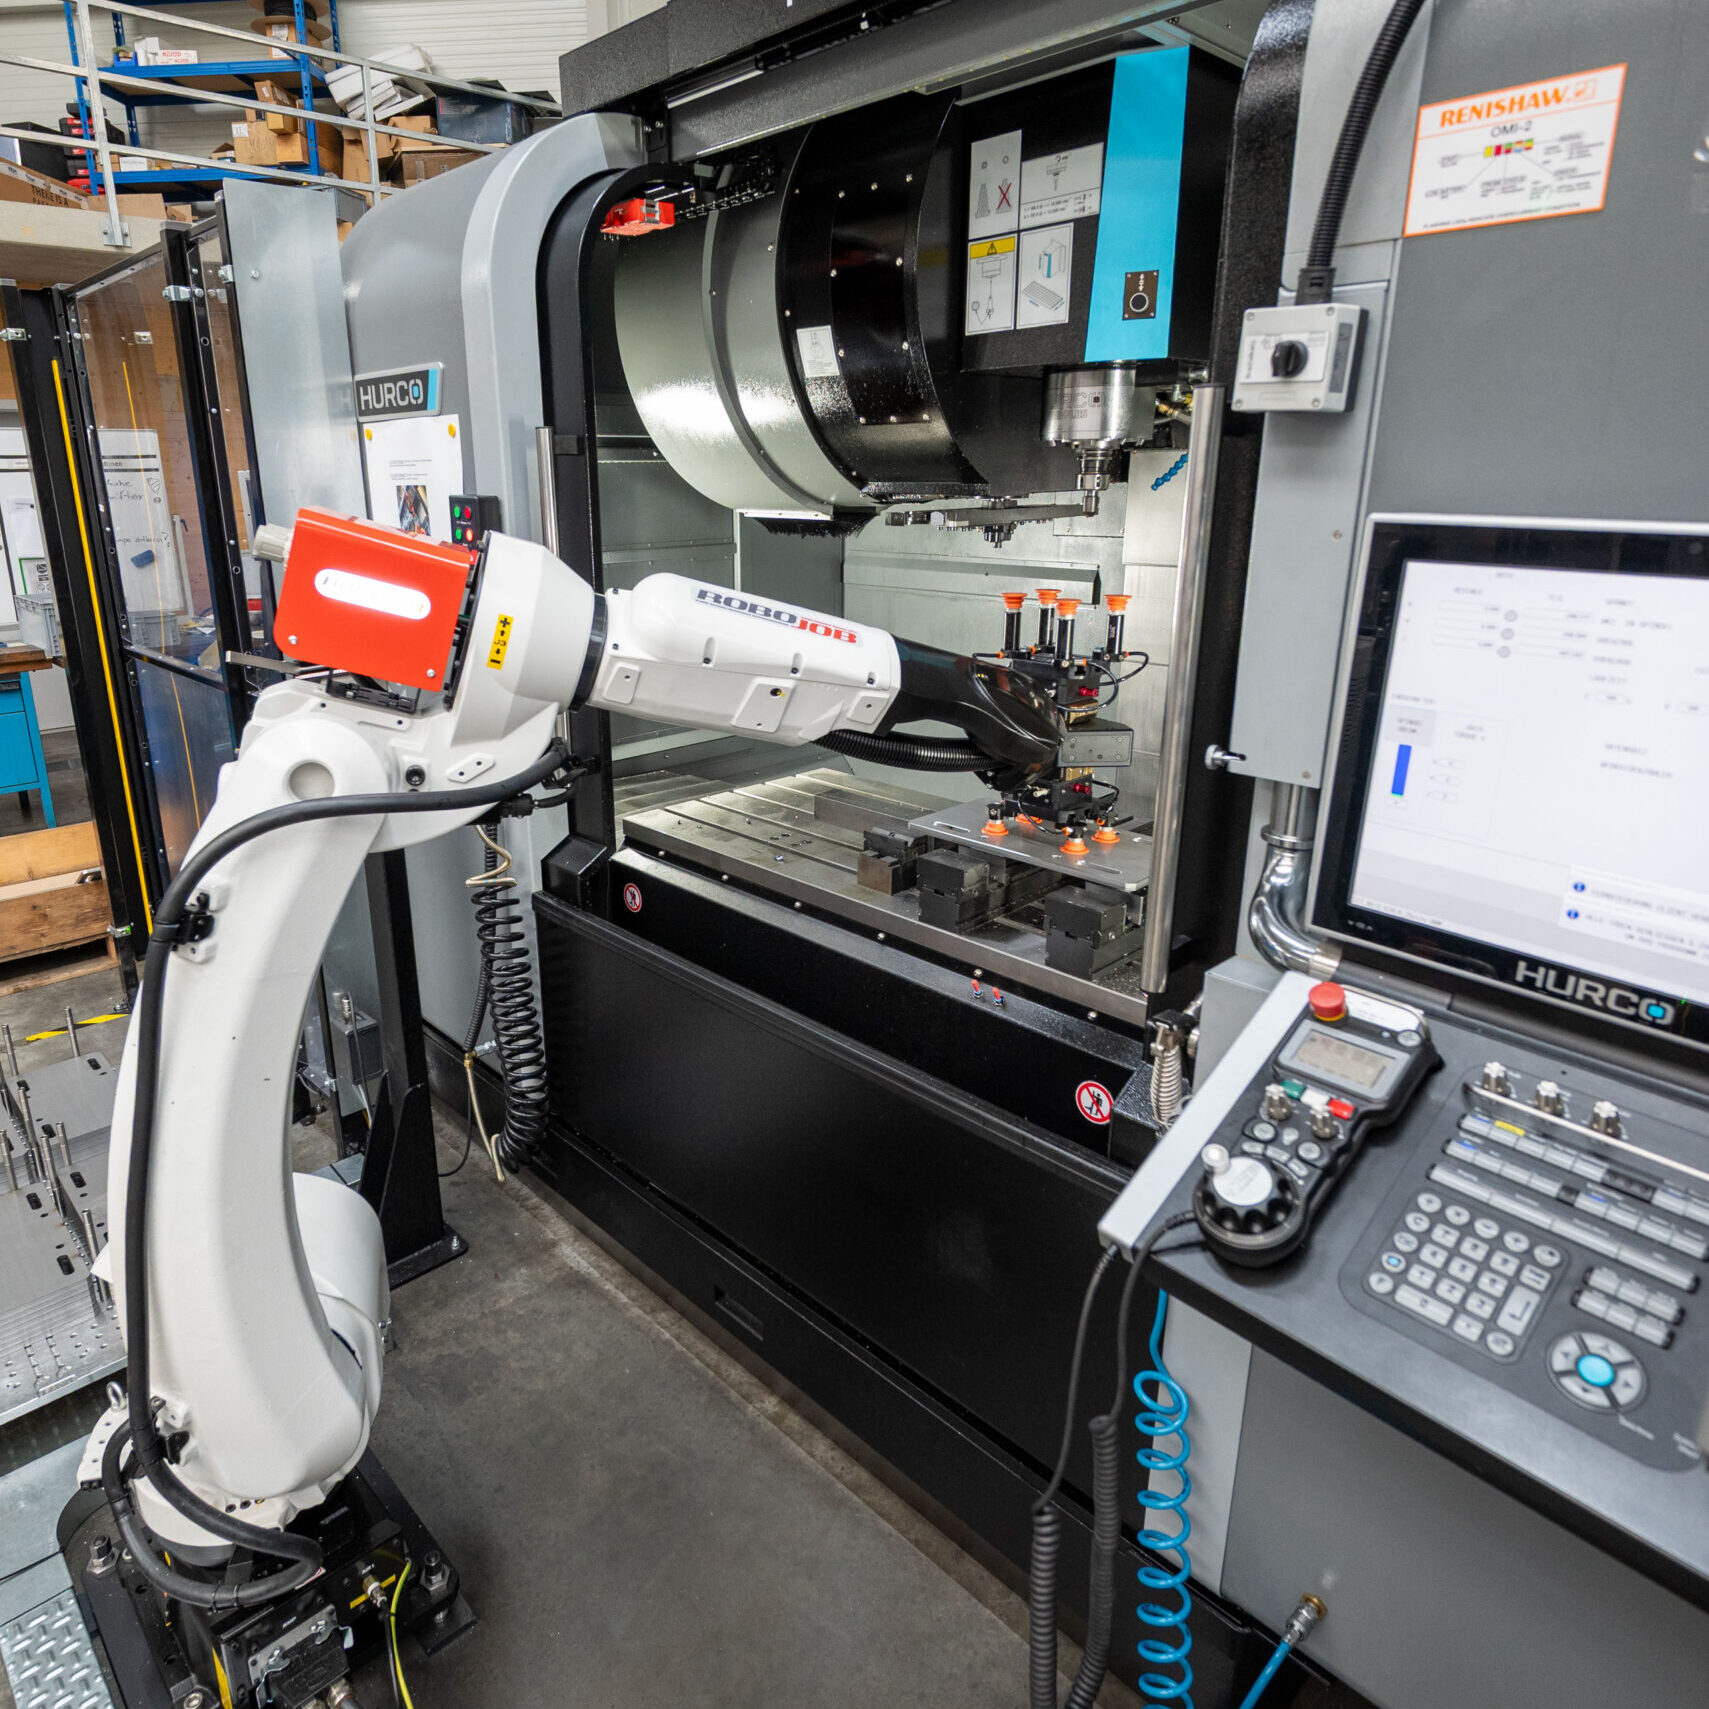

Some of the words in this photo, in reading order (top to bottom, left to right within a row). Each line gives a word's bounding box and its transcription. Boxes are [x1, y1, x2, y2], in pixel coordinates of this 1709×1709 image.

[1440, 87, 1568, 127] RENISHAW
[1490, 121, 1533, 138] OMI-2
[359, 378, 424, 411] HURCO
[1515, 960, 1675, 1026] HURCO
